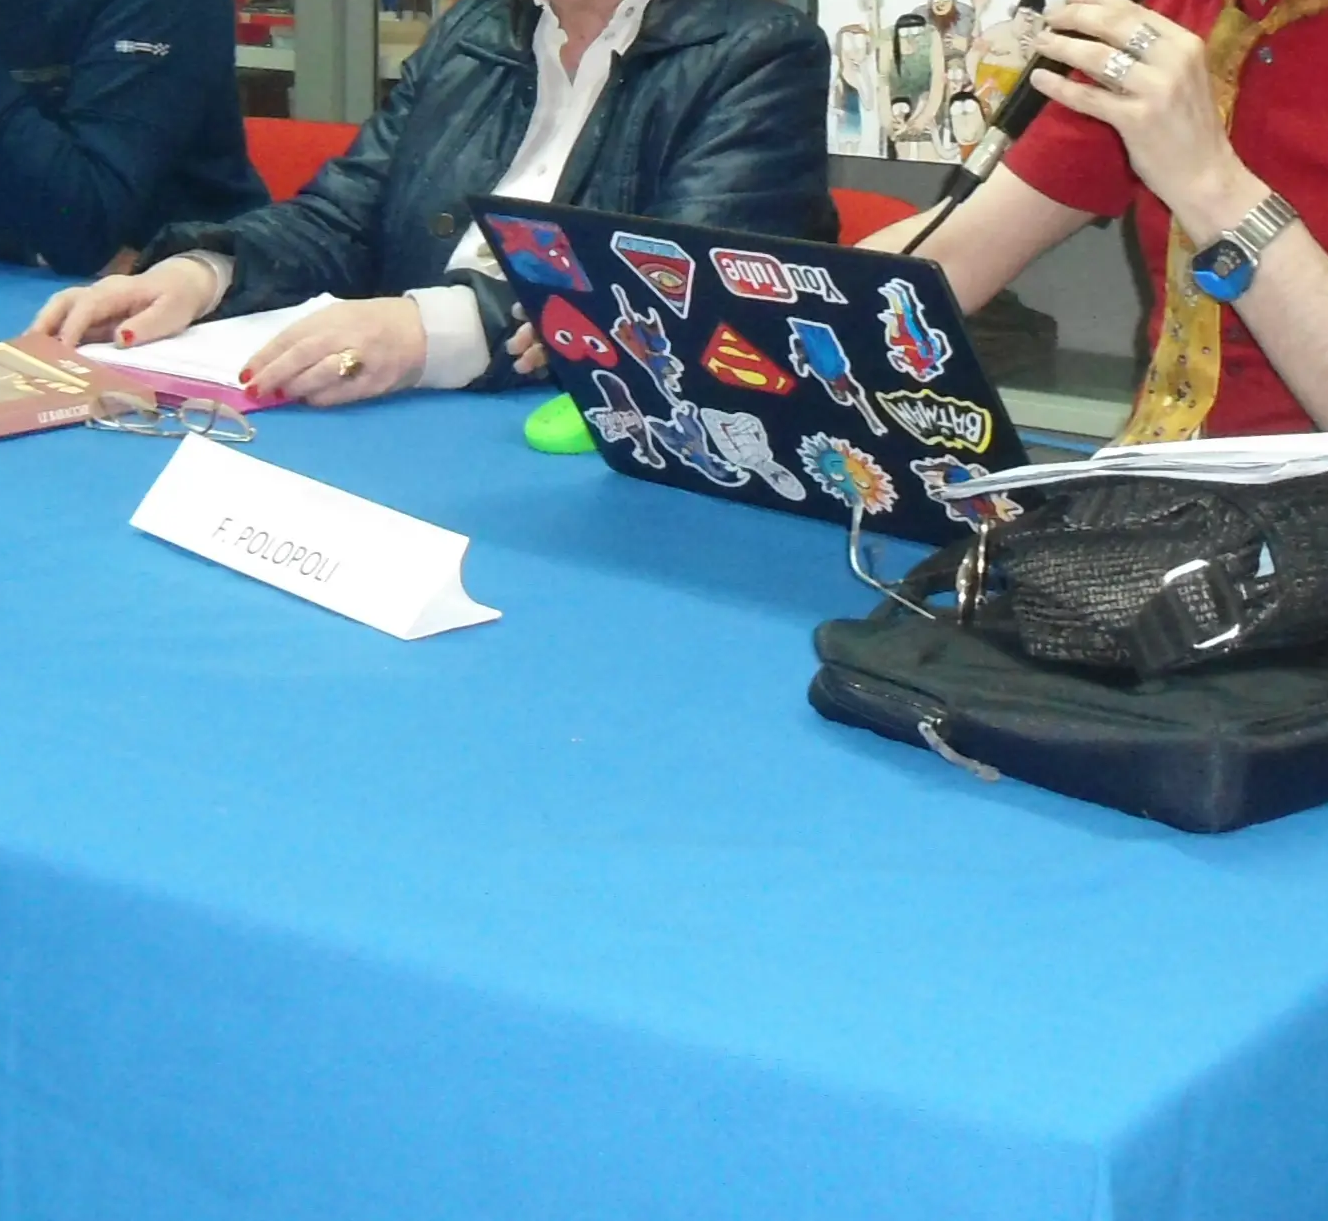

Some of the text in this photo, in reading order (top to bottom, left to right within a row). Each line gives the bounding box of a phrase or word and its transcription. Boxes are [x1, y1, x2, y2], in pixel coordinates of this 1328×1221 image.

[719, 256, 848, 305] YouTube
[884, 400, 984, 443] BATMAN
[211, 516, 343, 584] F. POLOPOLI
